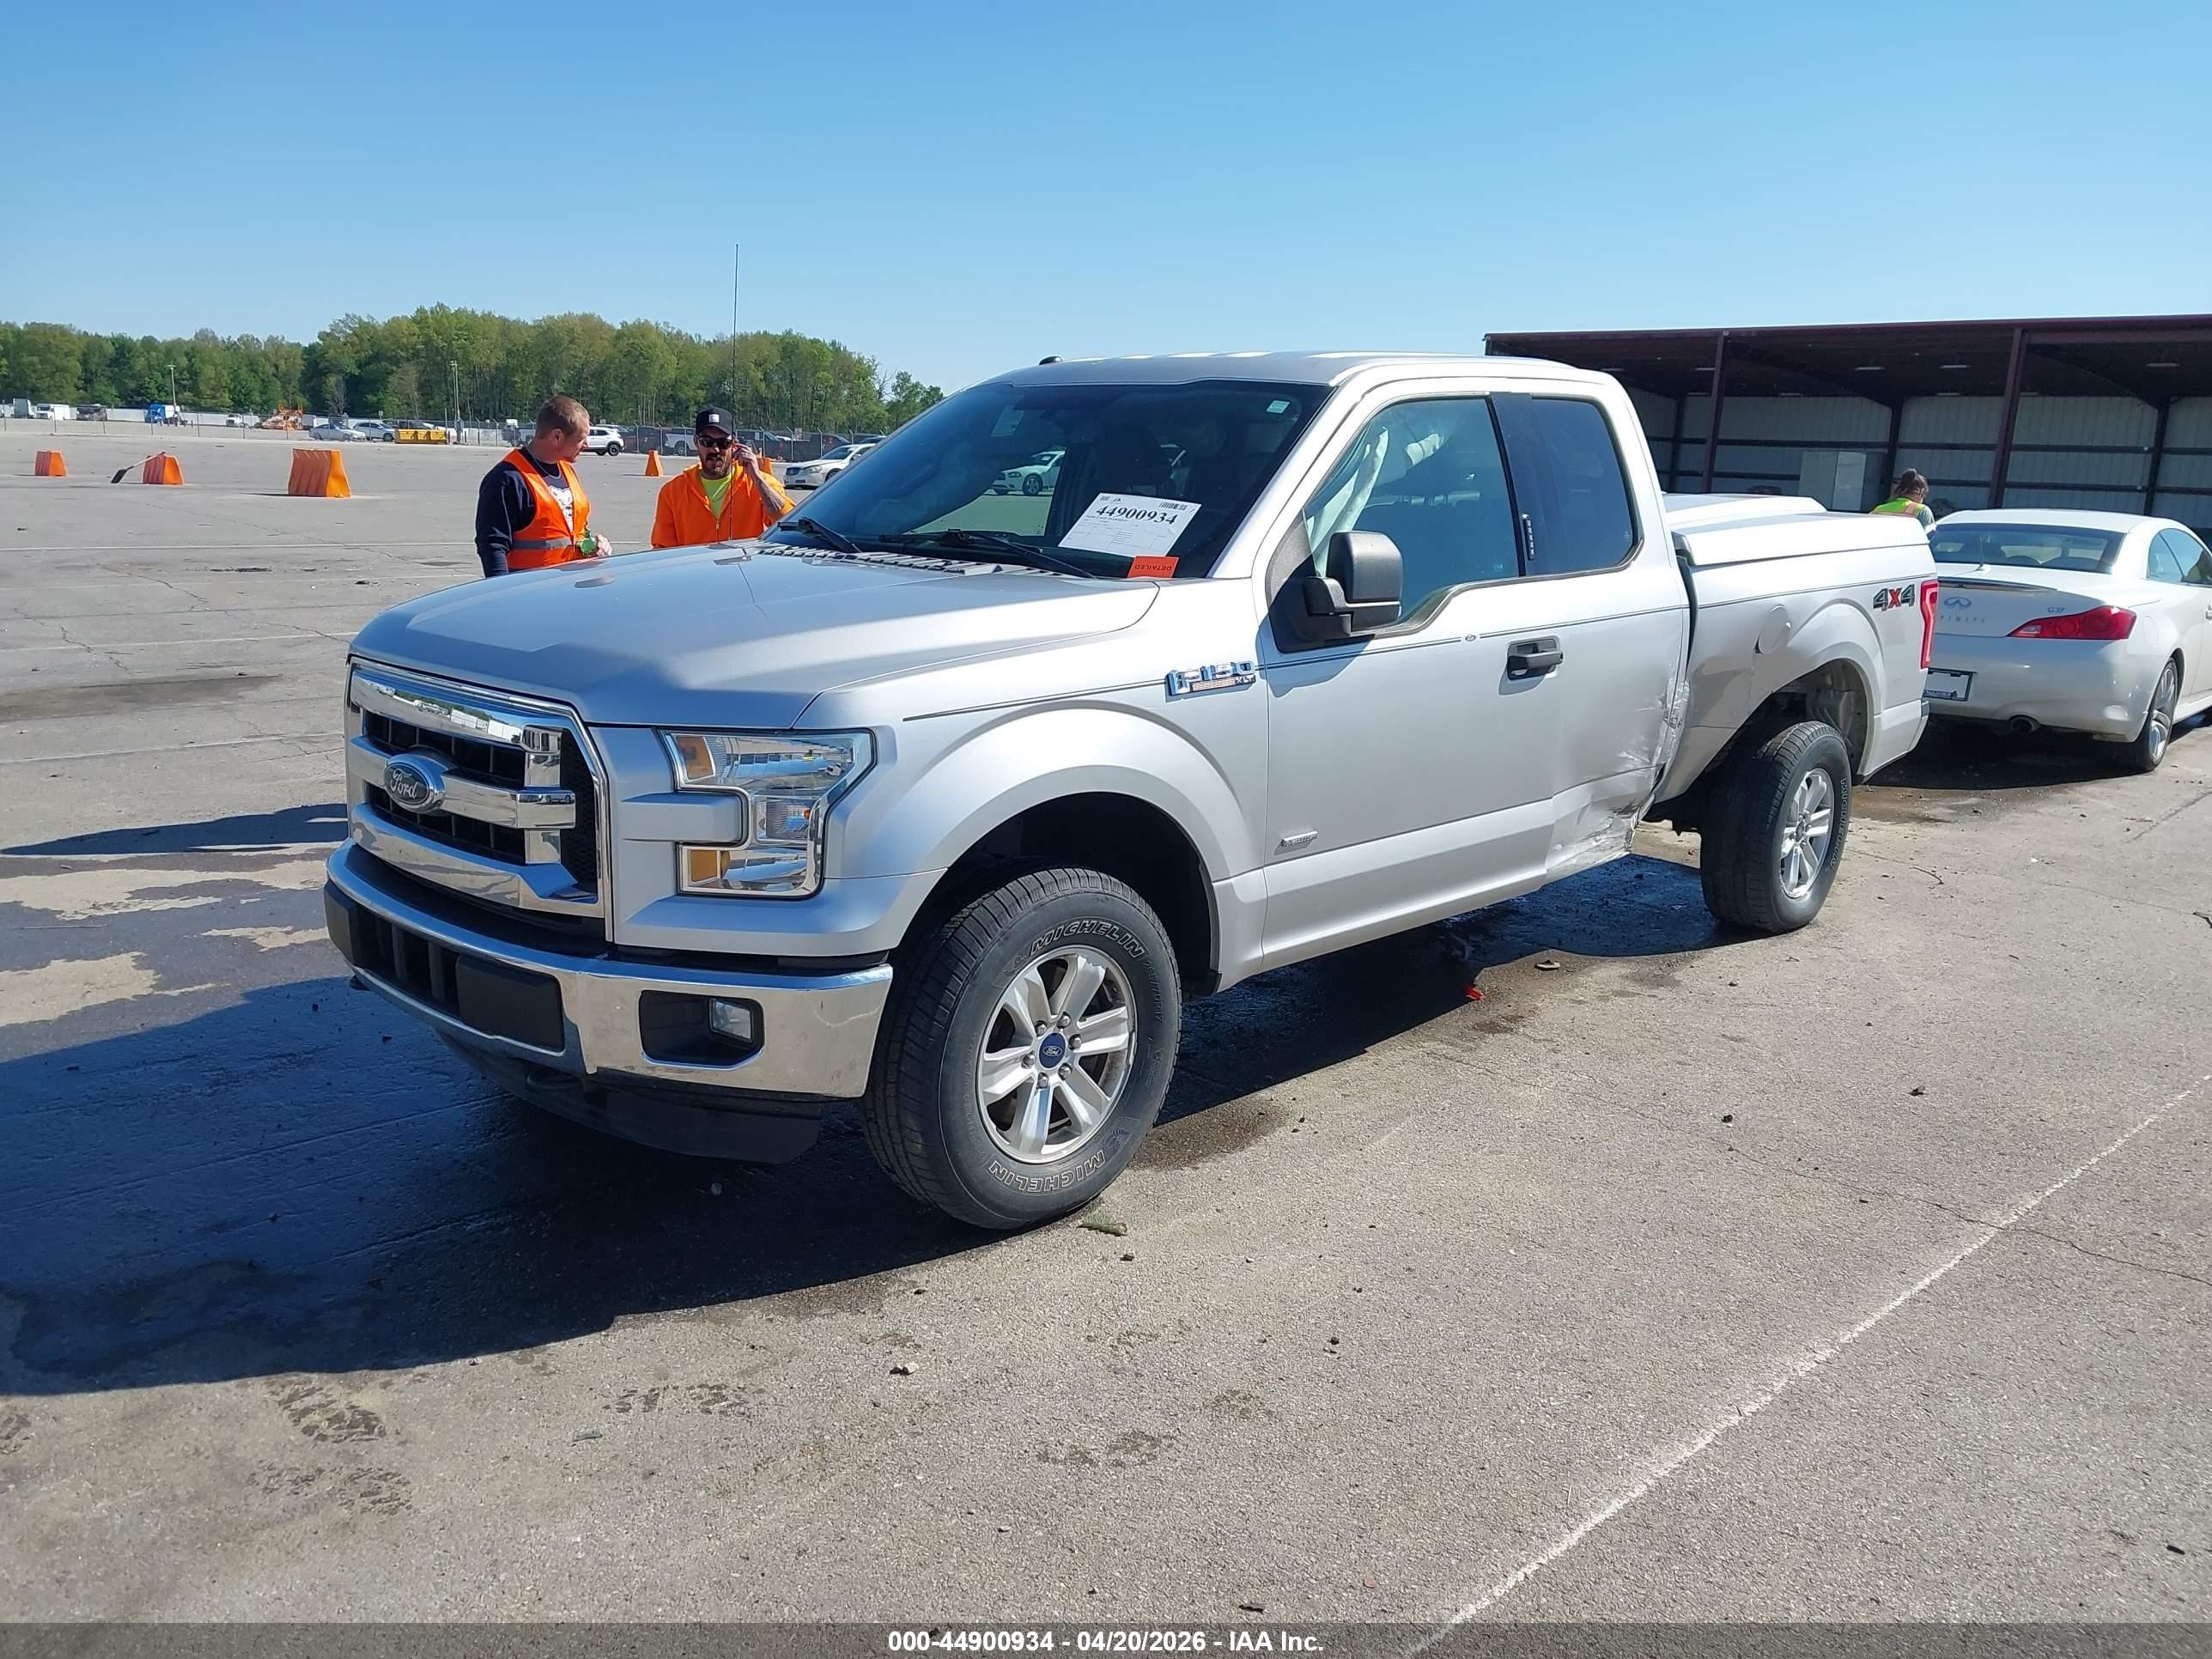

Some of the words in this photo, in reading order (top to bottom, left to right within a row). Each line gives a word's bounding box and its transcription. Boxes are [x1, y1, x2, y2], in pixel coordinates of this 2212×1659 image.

[1096, 505, 1178, 525] 44900934
[1235, 674, 1255, 685] XLT
[389, 768, 418, 799] Ford
[1030, 920, 1145, 958] MICHELIN
[988, 1149, 1106, 1193] MICHELIN
